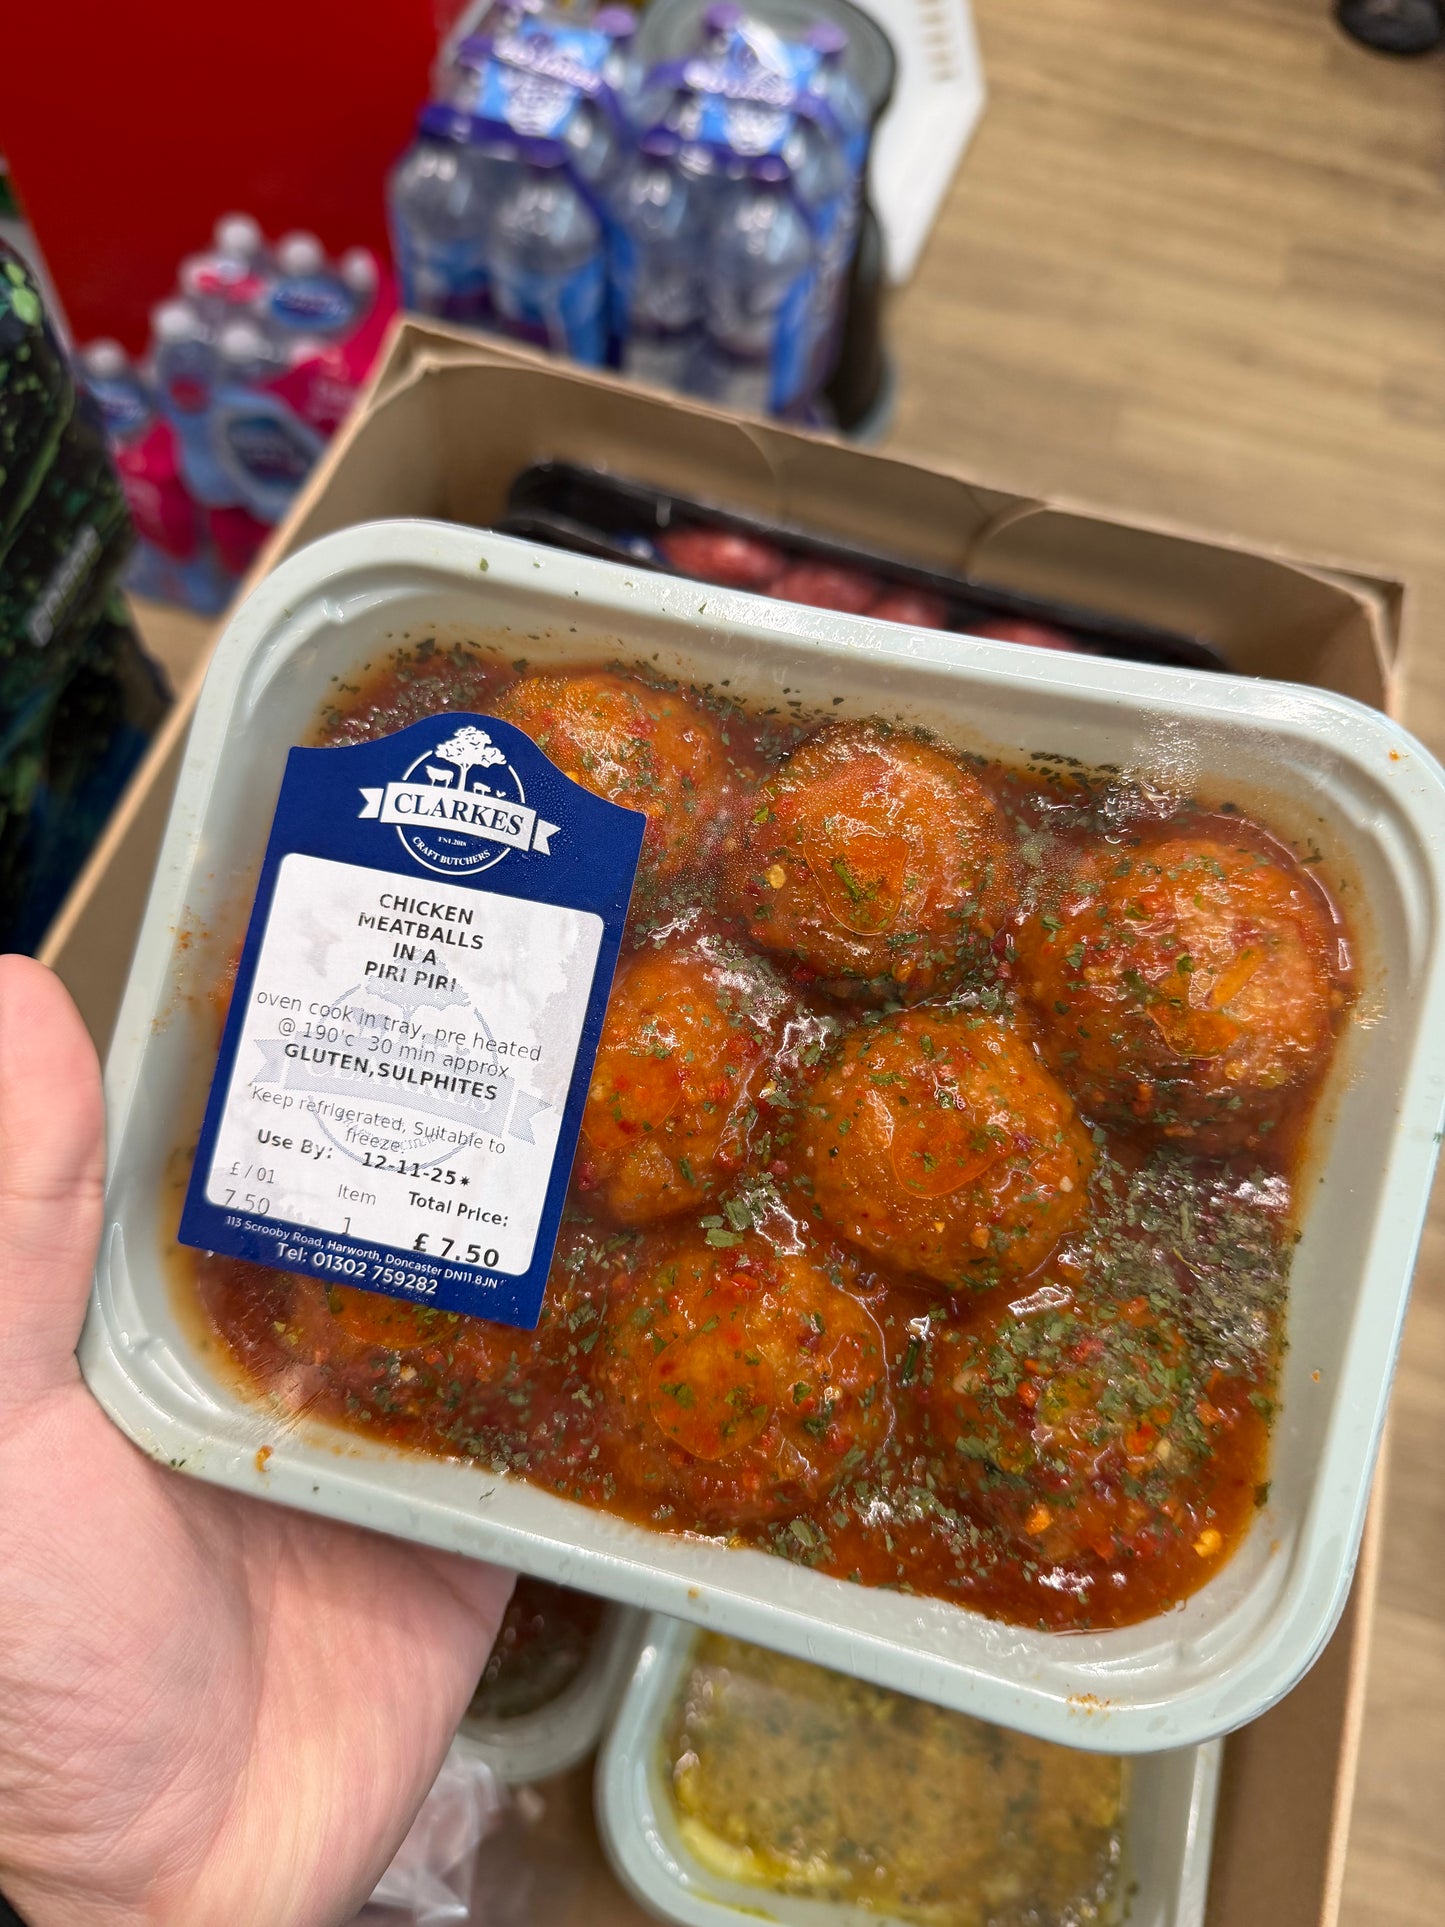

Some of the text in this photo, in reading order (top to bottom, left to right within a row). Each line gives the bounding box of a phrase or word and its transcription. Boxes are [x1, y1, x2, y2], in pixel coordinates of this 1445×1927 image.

[394, 793, 524, 836] CLARKES
[412, 836, 491, 866] CRAFT BUTCHERS
[379, 893, 474, 925] CHICKEN
[358, 912, 484, 950] MEATBALLS
[392, 942, 438, 966] IN A
[364, 960, 457, 993] PIRI PIRI
[257, 990, 542, 1062] oven cook in tray, pre heated
[277, 1018, 296, 1038] @
[370, 1034, 393, 1055] 30
[400, 1041, 436, 1064] min
[442, 1053, 510, 1080] approx
[250, 1086, 295, 1110] Keep
[299, 1099, 408, 1134] refrigerated,
[414, 1122, 484, 1151] Suitable
[489, 1136, 506, 1155] to
[257, 1128, 293, 1150] Use
[300, 1139, 335, 1160] By:
[223, 1188, 271, 1216] 7.50
[338, 1183, 377, 1206] Item
[408, 1191, 509, 1228] Total Price:
[341, 1216, 352, 1236] 1
[226, 1215, 498, 1289] 113 Scrooby Road, Harworth, Doncaster DN11 8JN
[412, 1232, 500, 1268] £ 7.50
[276, 1242, 439, 1295] Tel: 01302 759282
